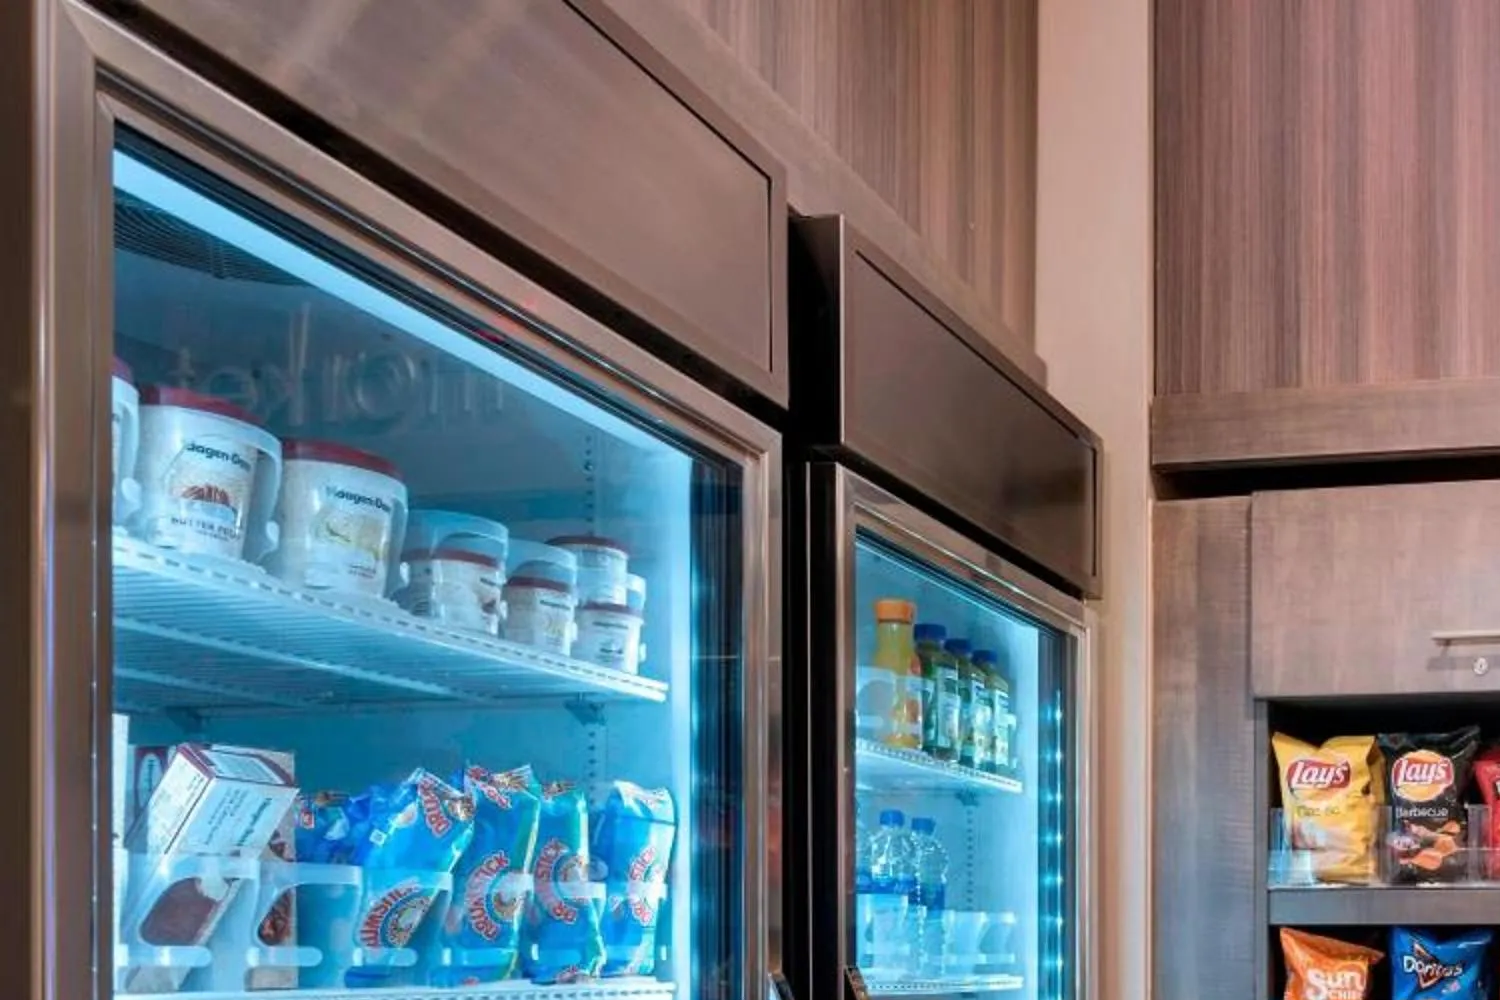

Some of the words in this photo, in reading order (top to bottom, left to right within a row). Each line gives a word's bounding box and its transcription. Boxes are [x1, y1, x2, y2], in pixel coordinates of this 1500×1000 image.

[1290, 759, 1349, 789] Lay's
[1395, 756, 1448, 787] Lay's
[534, 837, 577, 925] DRSTICK
[1402, 954, 1463, 979] Doritos
